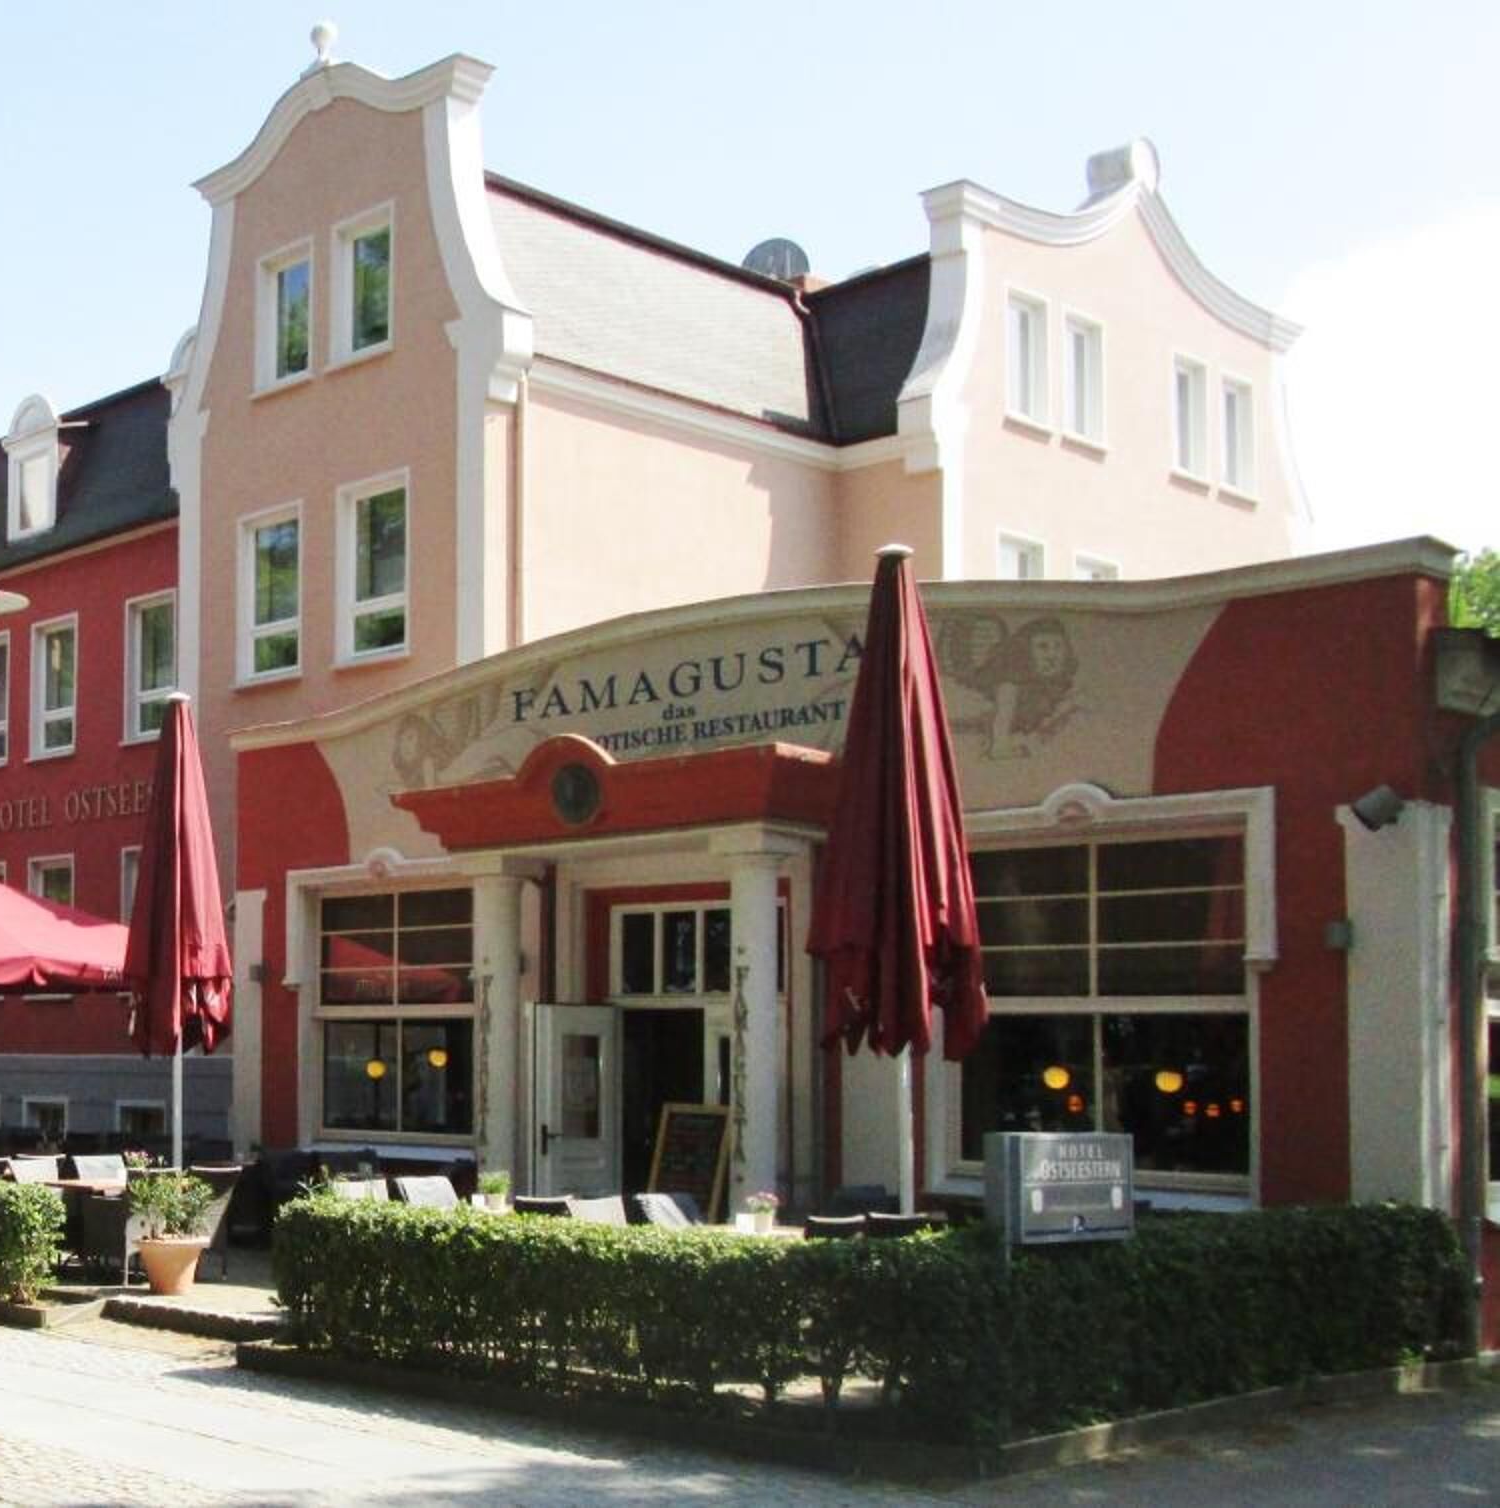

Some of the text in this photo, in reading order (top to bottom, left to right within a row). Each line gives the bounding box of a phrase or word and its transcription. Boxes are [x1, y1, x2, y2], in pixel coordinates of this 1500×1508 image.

[513, 633, 865, 723] FAMAGUSTA
[593, 701, 846, 755] OTISCHE RESTAURANT
[662, 702, 696, 721] das
[1058, 1143, 1106, 1160] HOTEL
